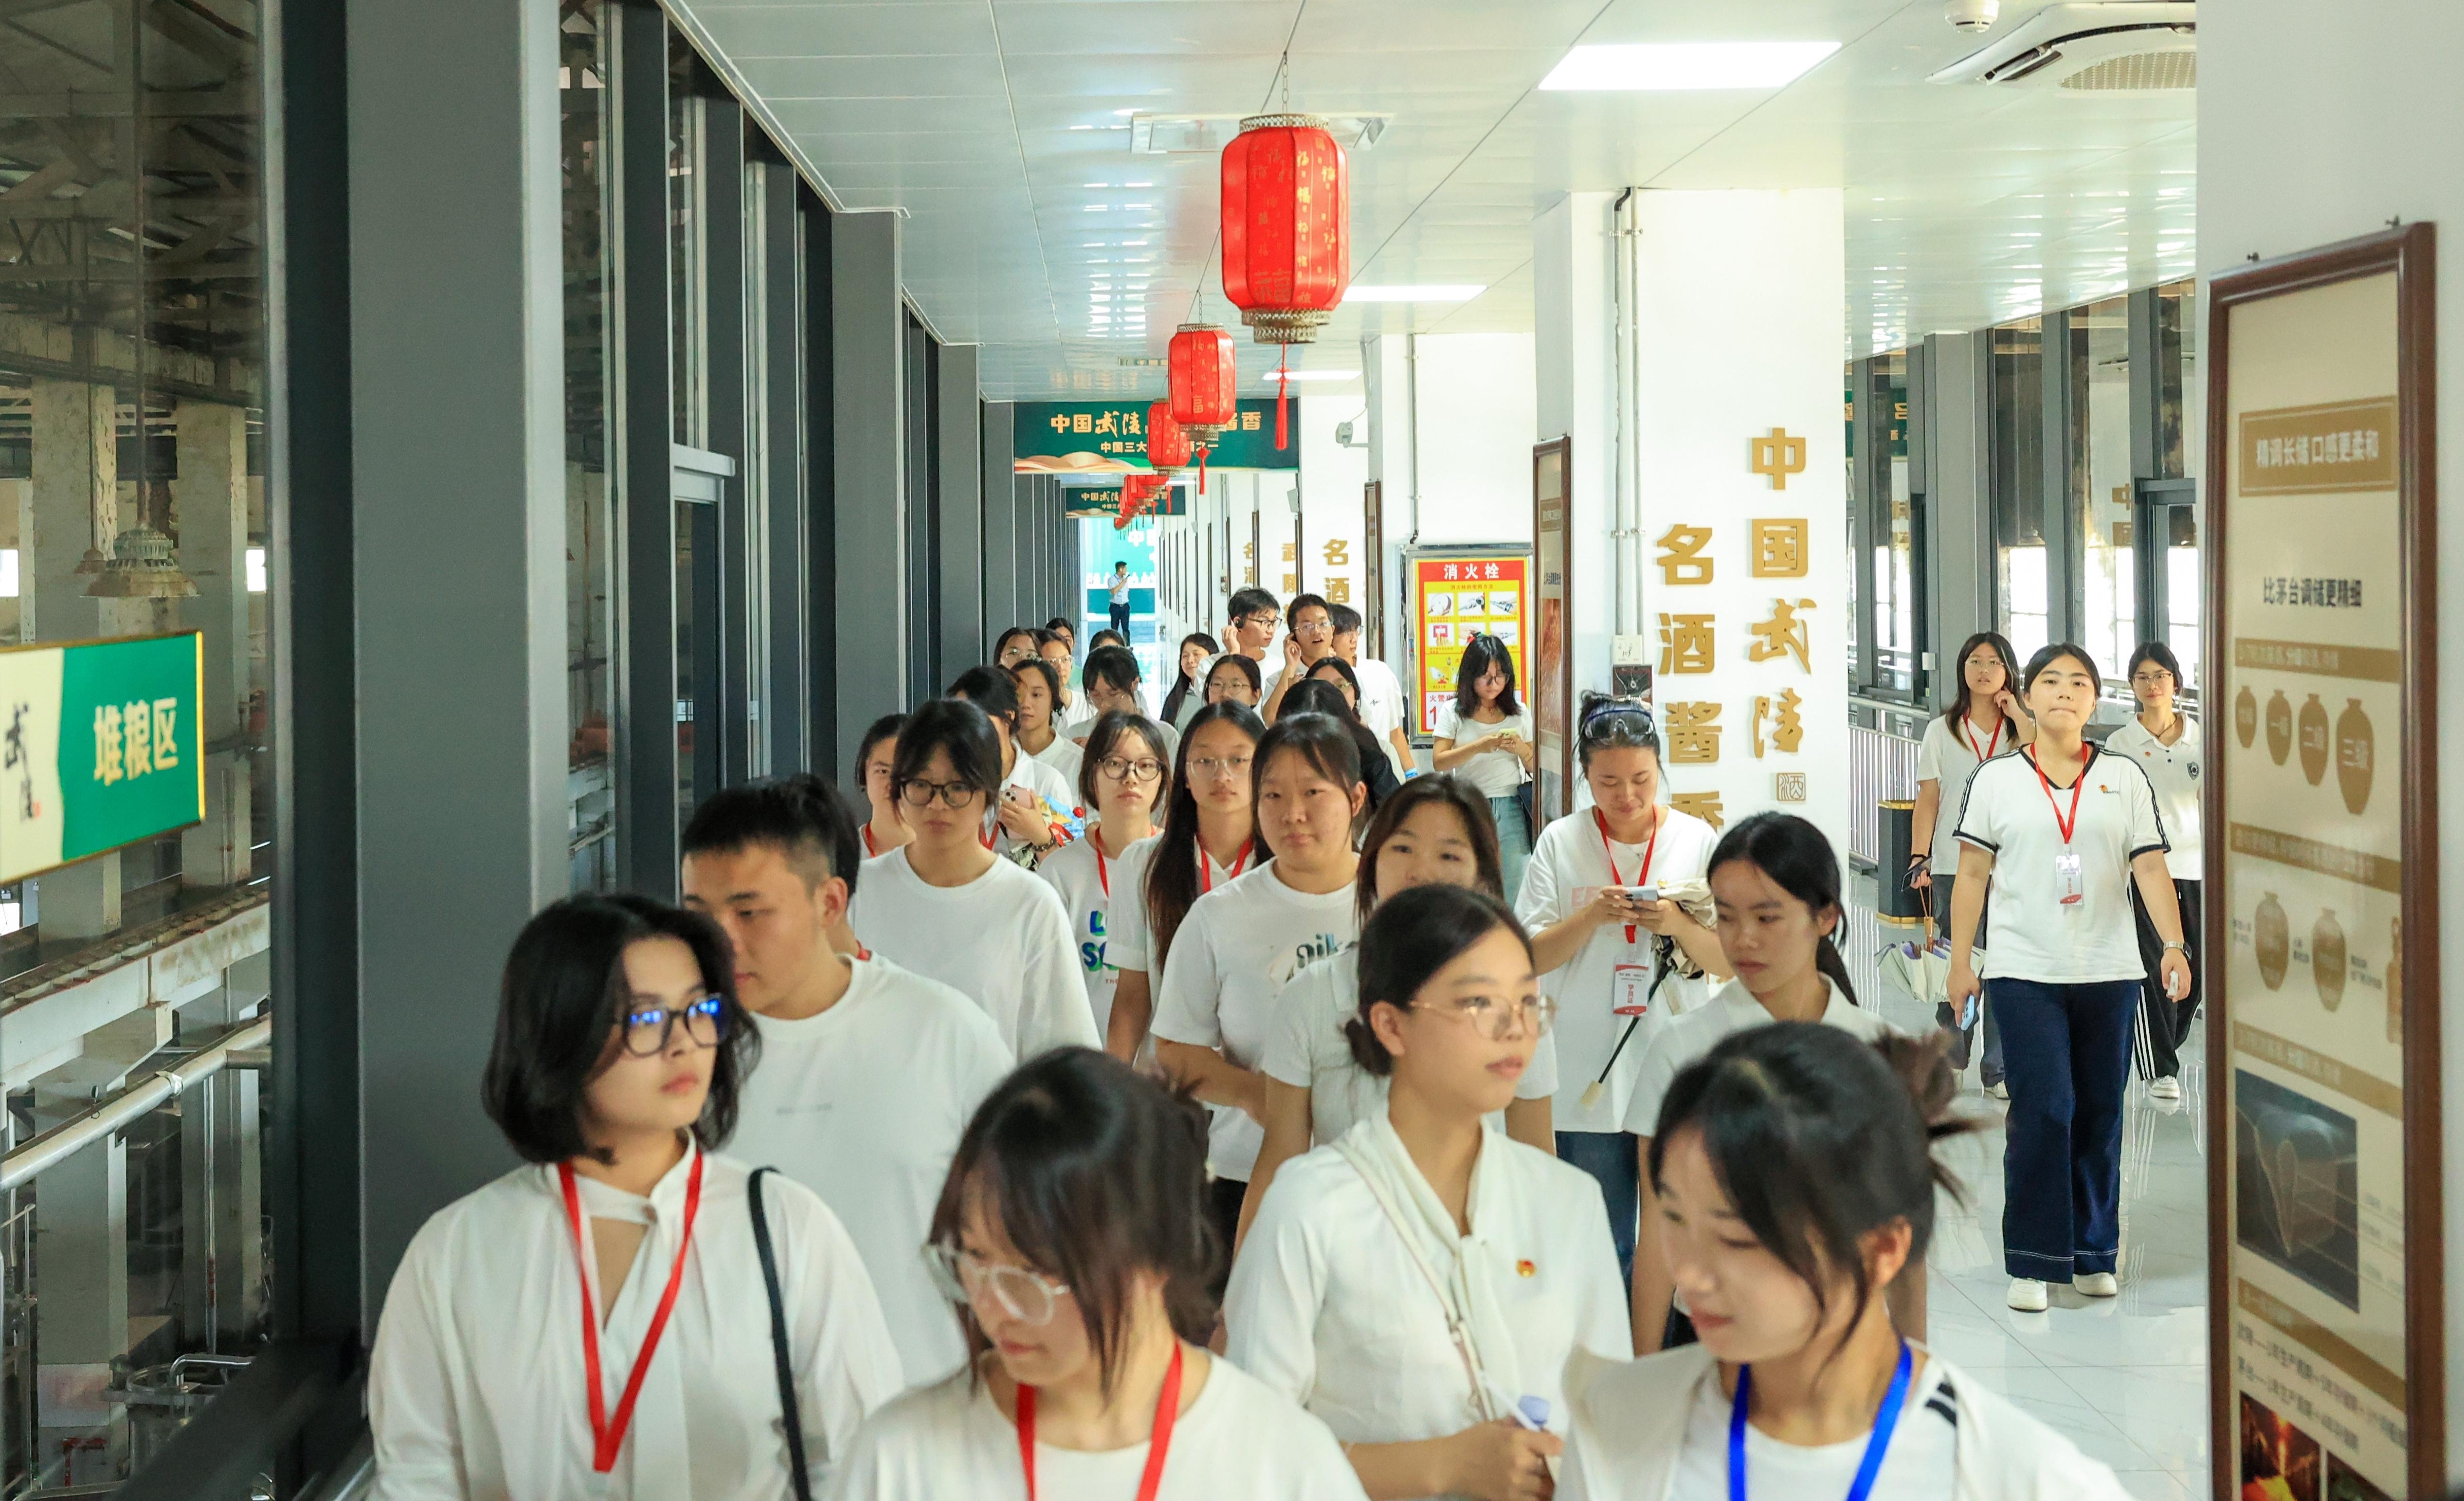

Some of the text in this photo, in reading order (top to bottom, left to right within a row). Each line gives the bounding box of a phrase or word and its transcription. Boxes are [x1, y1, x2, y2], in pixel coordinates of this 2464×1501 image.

[1443, 563, 1499, 580] 消火栓
[1751, 427, 1817, 759] 中国武陵
